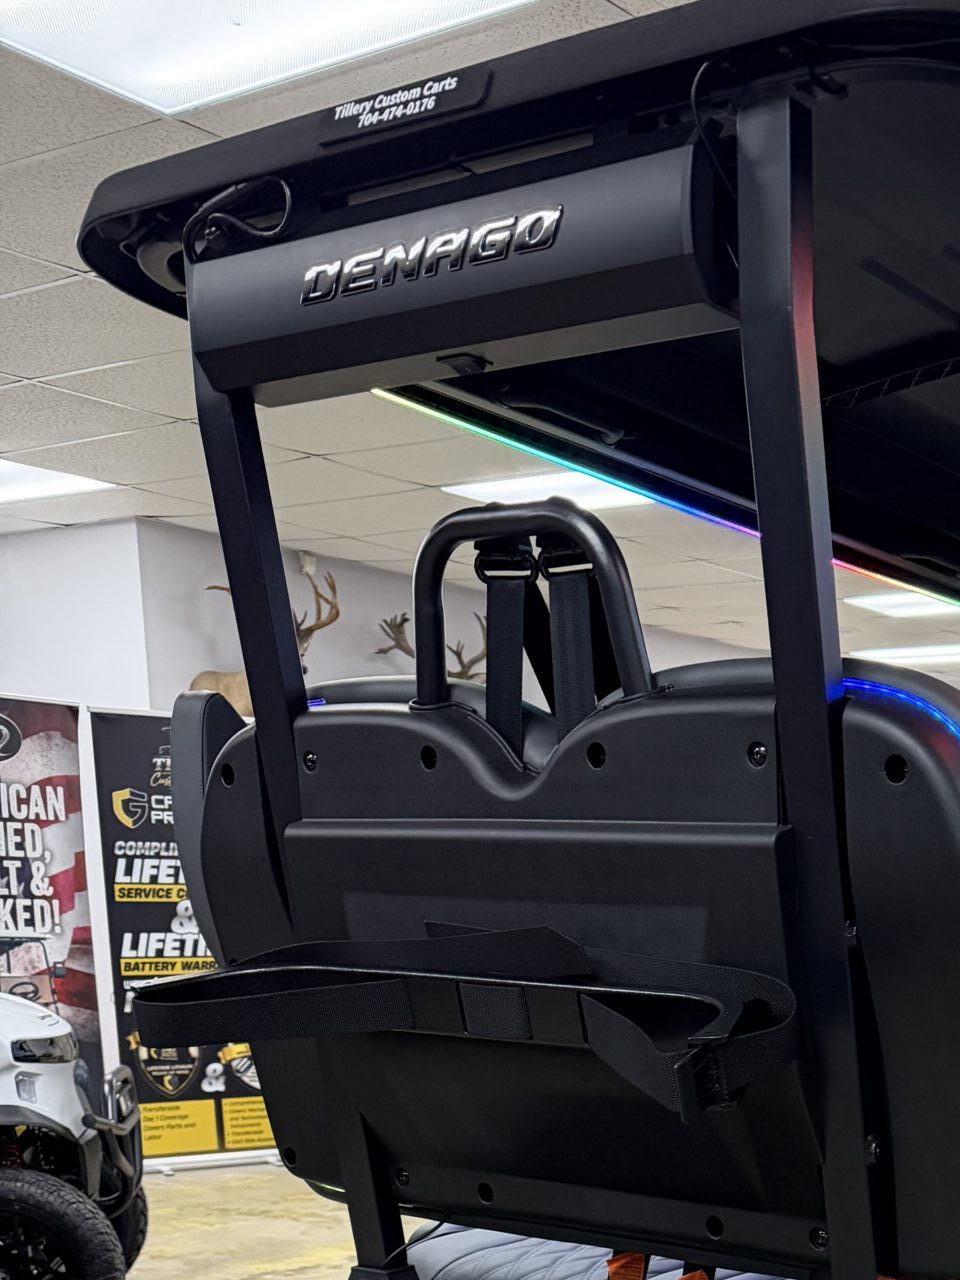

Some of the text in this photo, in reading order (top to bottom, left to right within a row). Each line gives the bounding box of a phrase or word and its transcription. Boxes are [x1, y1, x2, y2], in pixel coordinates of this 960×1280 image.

[334, 77, 458, 120] Tillery Custom Carts
[358, 96, 436, 128] 704-474-0176
[300, 205, 564, 306] DENAGO
[30, 861, 54, 896] &
[117, 887, 173, 899] SERVICE
[121, 932, 213, 957] LIFETI
[123, 962, 177, 972] BATTERY
